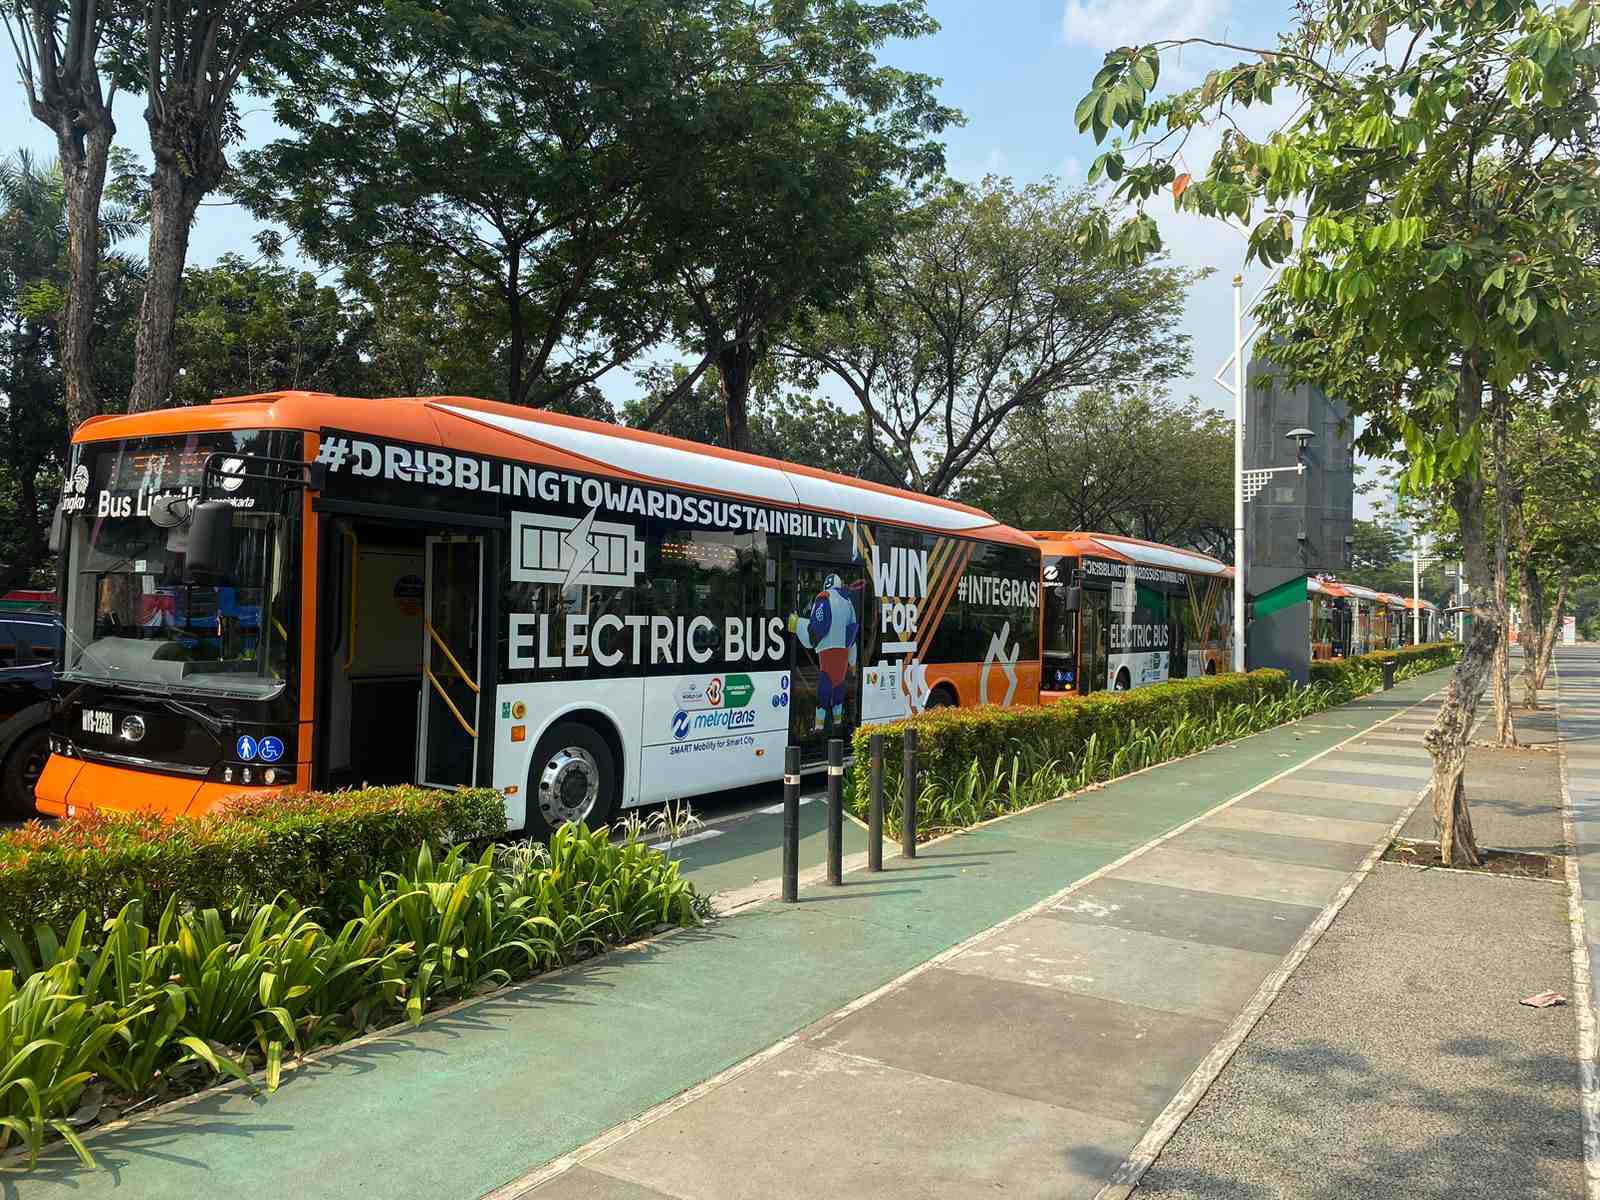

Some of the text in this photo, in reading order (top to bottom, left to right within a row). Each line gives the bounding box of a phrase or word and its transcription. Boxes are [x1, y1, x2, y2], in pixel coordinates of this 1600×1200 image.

[98, 489, 132, 518] Bus
[871, 544, 929, 599] WIN
[881, 603, 918, 634] FOR
[508, 613, 785, 670] ELECTRIC BUS
[1110, 624, 1169, 649] ELECTRIC BUS
[694, 709, 756, 730] metrotrans
[669, 743, 693, 755] SMART
[694, 740, 716, 752] Mobility
[726, 737, 743, 748] Smart
[744, 735, 755, 746] City
